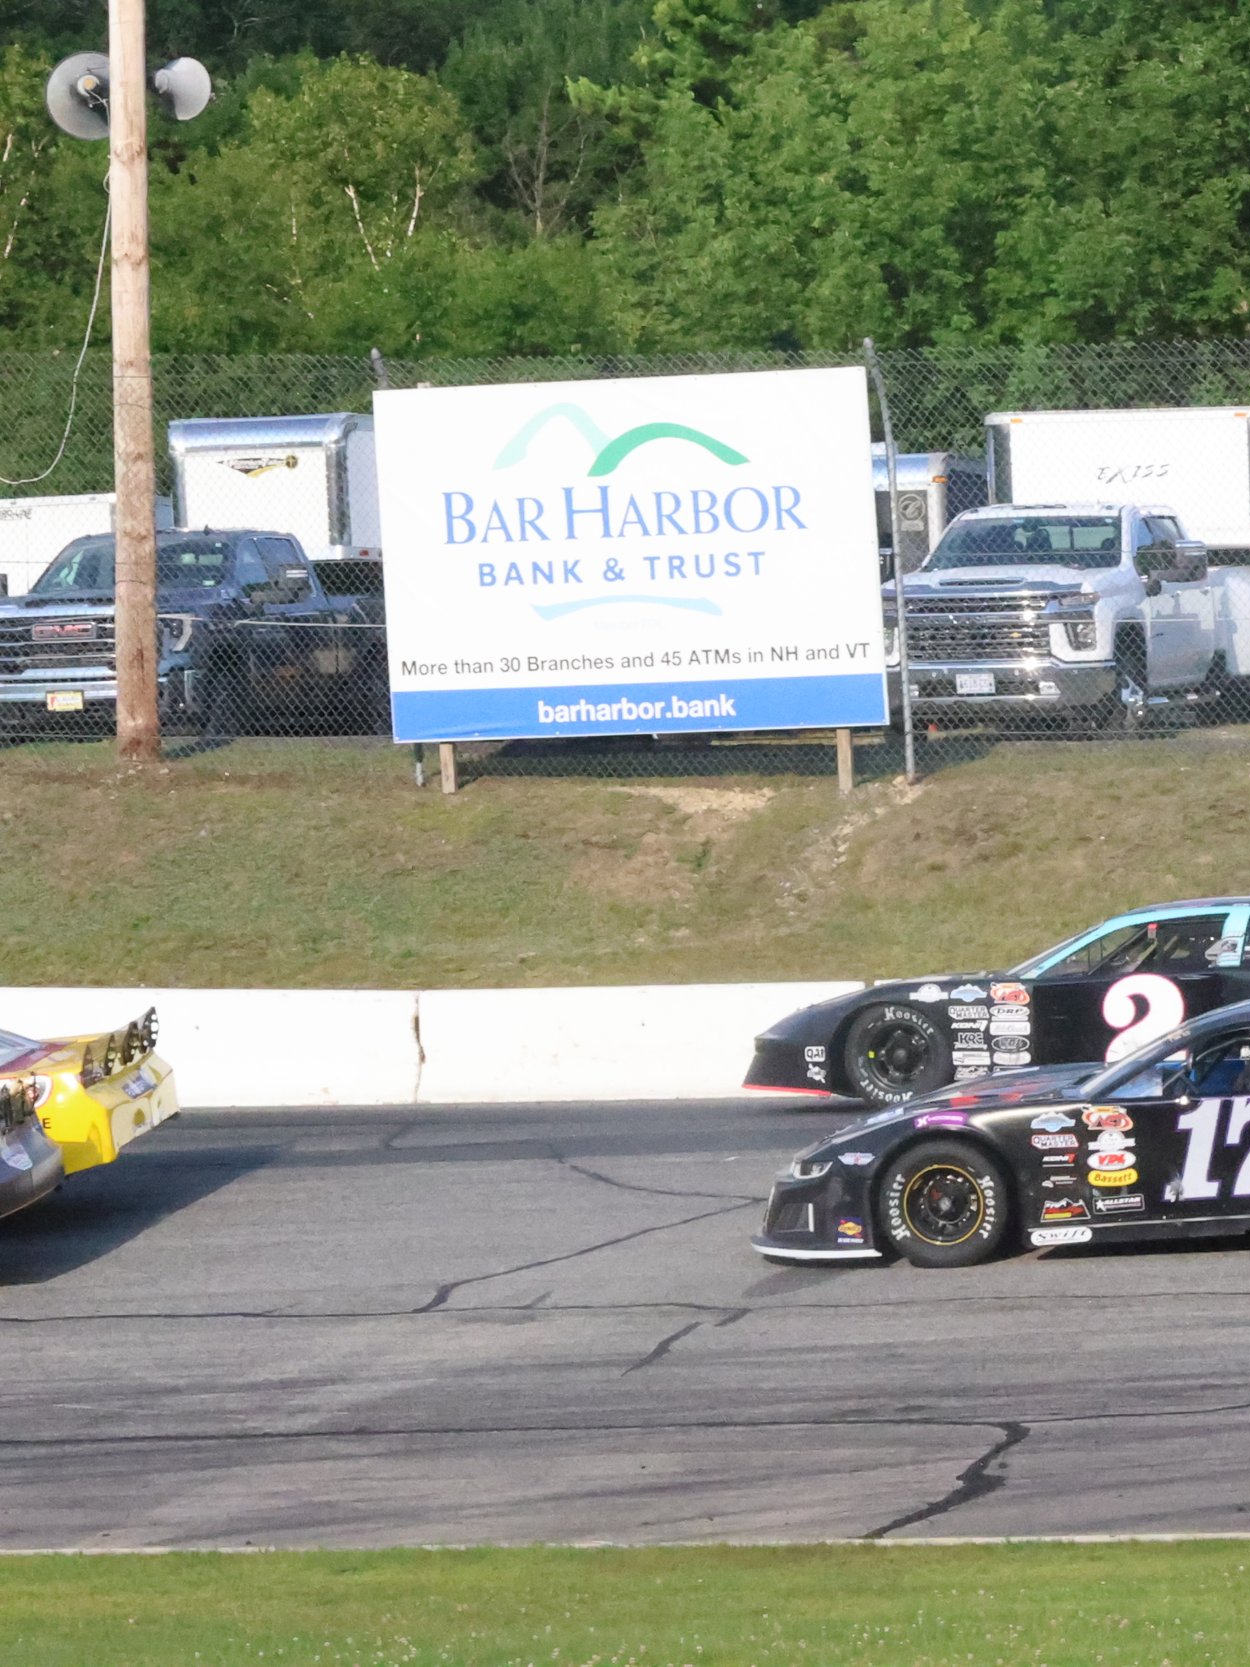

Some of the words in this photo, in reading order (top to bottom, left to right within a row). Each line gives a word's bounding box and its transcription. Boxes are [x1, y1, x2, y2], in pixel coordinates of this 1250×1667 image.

[441, 489, 551, 546] BAR
[561, 483, 808, 542] HARBOR
[477, 558, 584, 588] BANK
[602, 557, 627, 583] &
[642, 550, 767, 582] TRUST
[401, 659, 448, 678] More
[453, 658, 494, 675] than
[500, 656, 521, 674] 30
[527, 653, 615, 673] Branches
[620, 651, 655, 669] and
[660, 650, 682, 668] 45
[688, 647, 742, 667] ATMs
[748, 646, 764, 663] in
[770, 644, 799, 662] NH
[805, 643, 840, 661] and
[846, 642, 871, 660] VT
[537, 693, 737, 724] barharbor.bank
[884, 1006, 935, 1035] Hoosier
[949, 1006, 987, 1015] QUARTER
[1102, 972, 1187, 1067] 2
[1033, 1134, 1075, 1144] QUARTER
[1040, 1139, 1077, 1148] MASTER
[1094, 1172, 1133, 1184] Bassett
[888, 1173, 911, 1240] Hoosier
[976, 1175, 996, 1240] Hoosier
